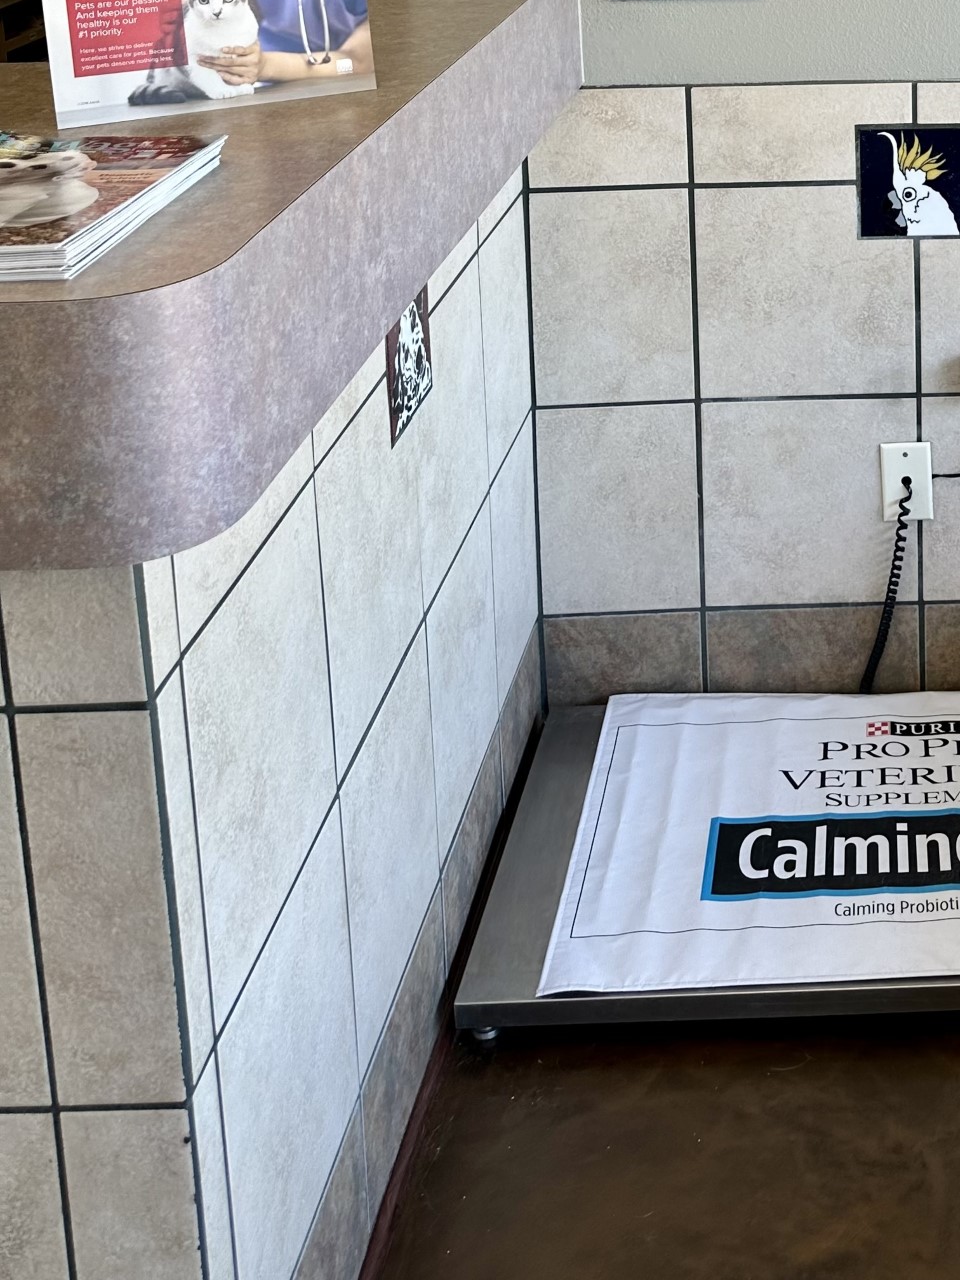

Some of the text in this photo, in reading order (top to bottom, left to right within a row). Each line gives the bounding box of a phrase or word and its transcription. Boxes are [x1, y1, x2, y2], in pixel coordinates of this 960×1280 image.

[75, 1, 94, 10] Pets
[114, 0, 128, 7] our
[76, 4, 158, 20] And keeping them
[77, 16, 137, 30] healthy is our
[78, 28, 124, 39] #1 priority.
[834, 900, 895, 917] Calming
